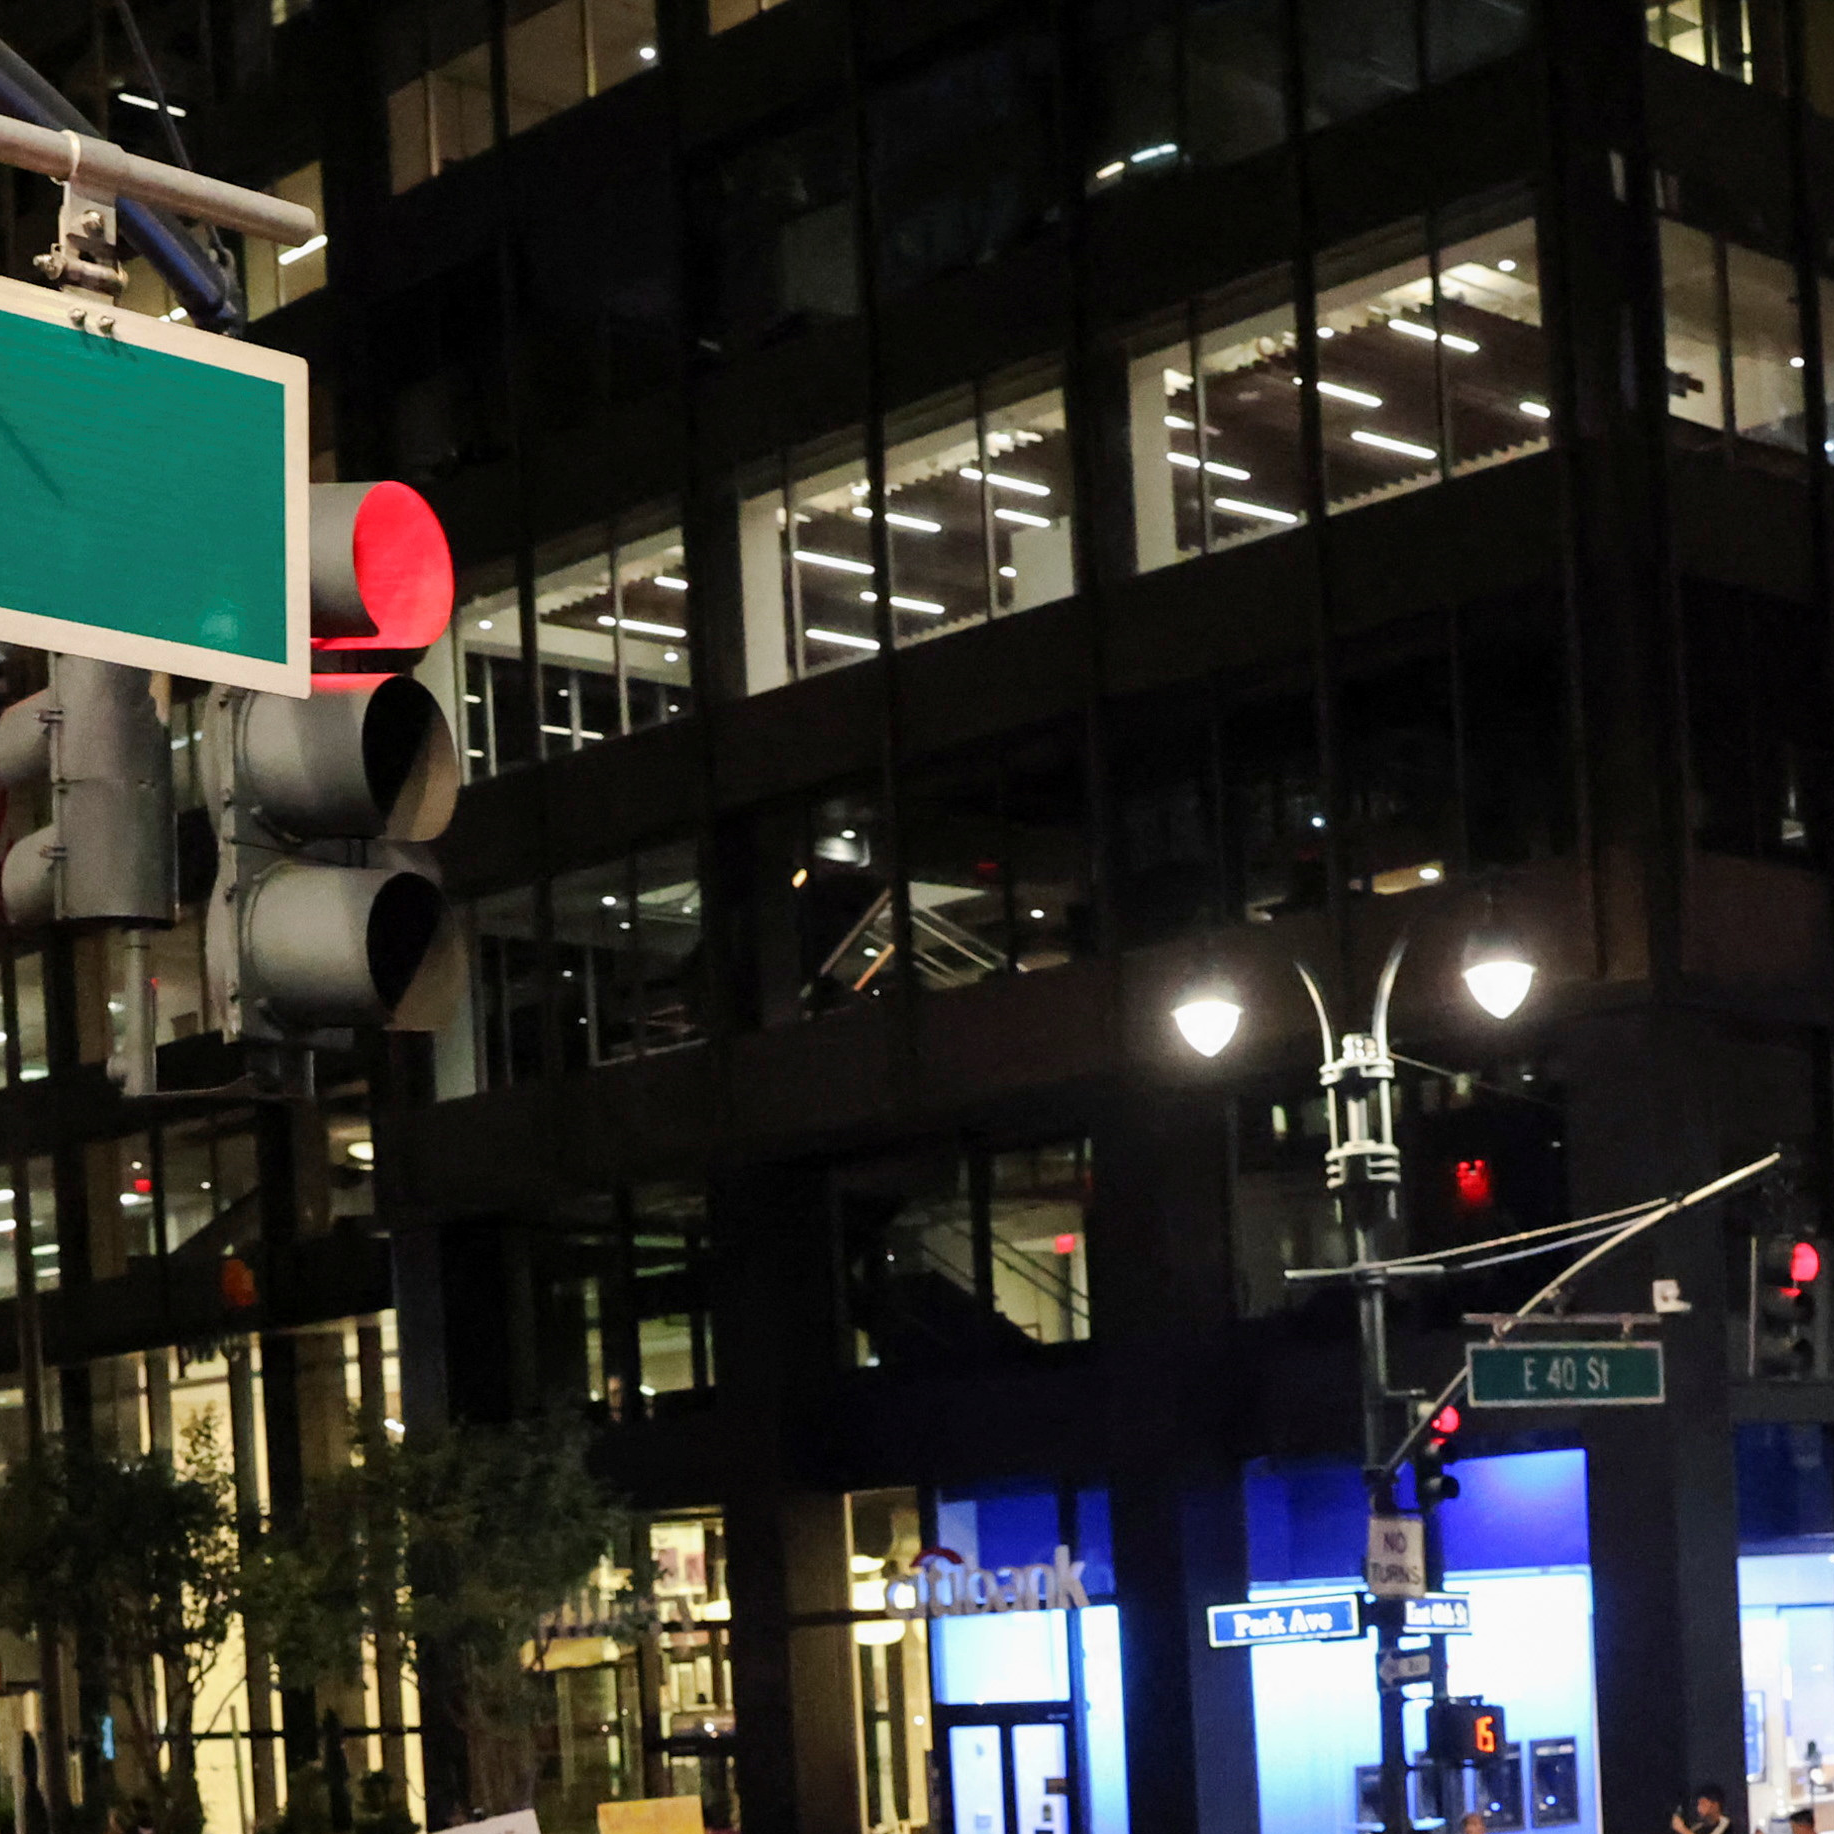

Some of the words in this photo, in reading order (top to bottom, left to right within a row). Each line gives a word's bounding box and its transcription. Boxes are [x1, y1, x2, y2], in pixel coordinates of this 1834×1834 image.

[1522, 1357, 1538, 1392] E
[1546, 1356, 1577, 1392] 40
[1586, 1355, 1610, 1391] St
[1383, 1532, 1407, 1553] NO
[1289, 1608, 1333, 1632] Ave
